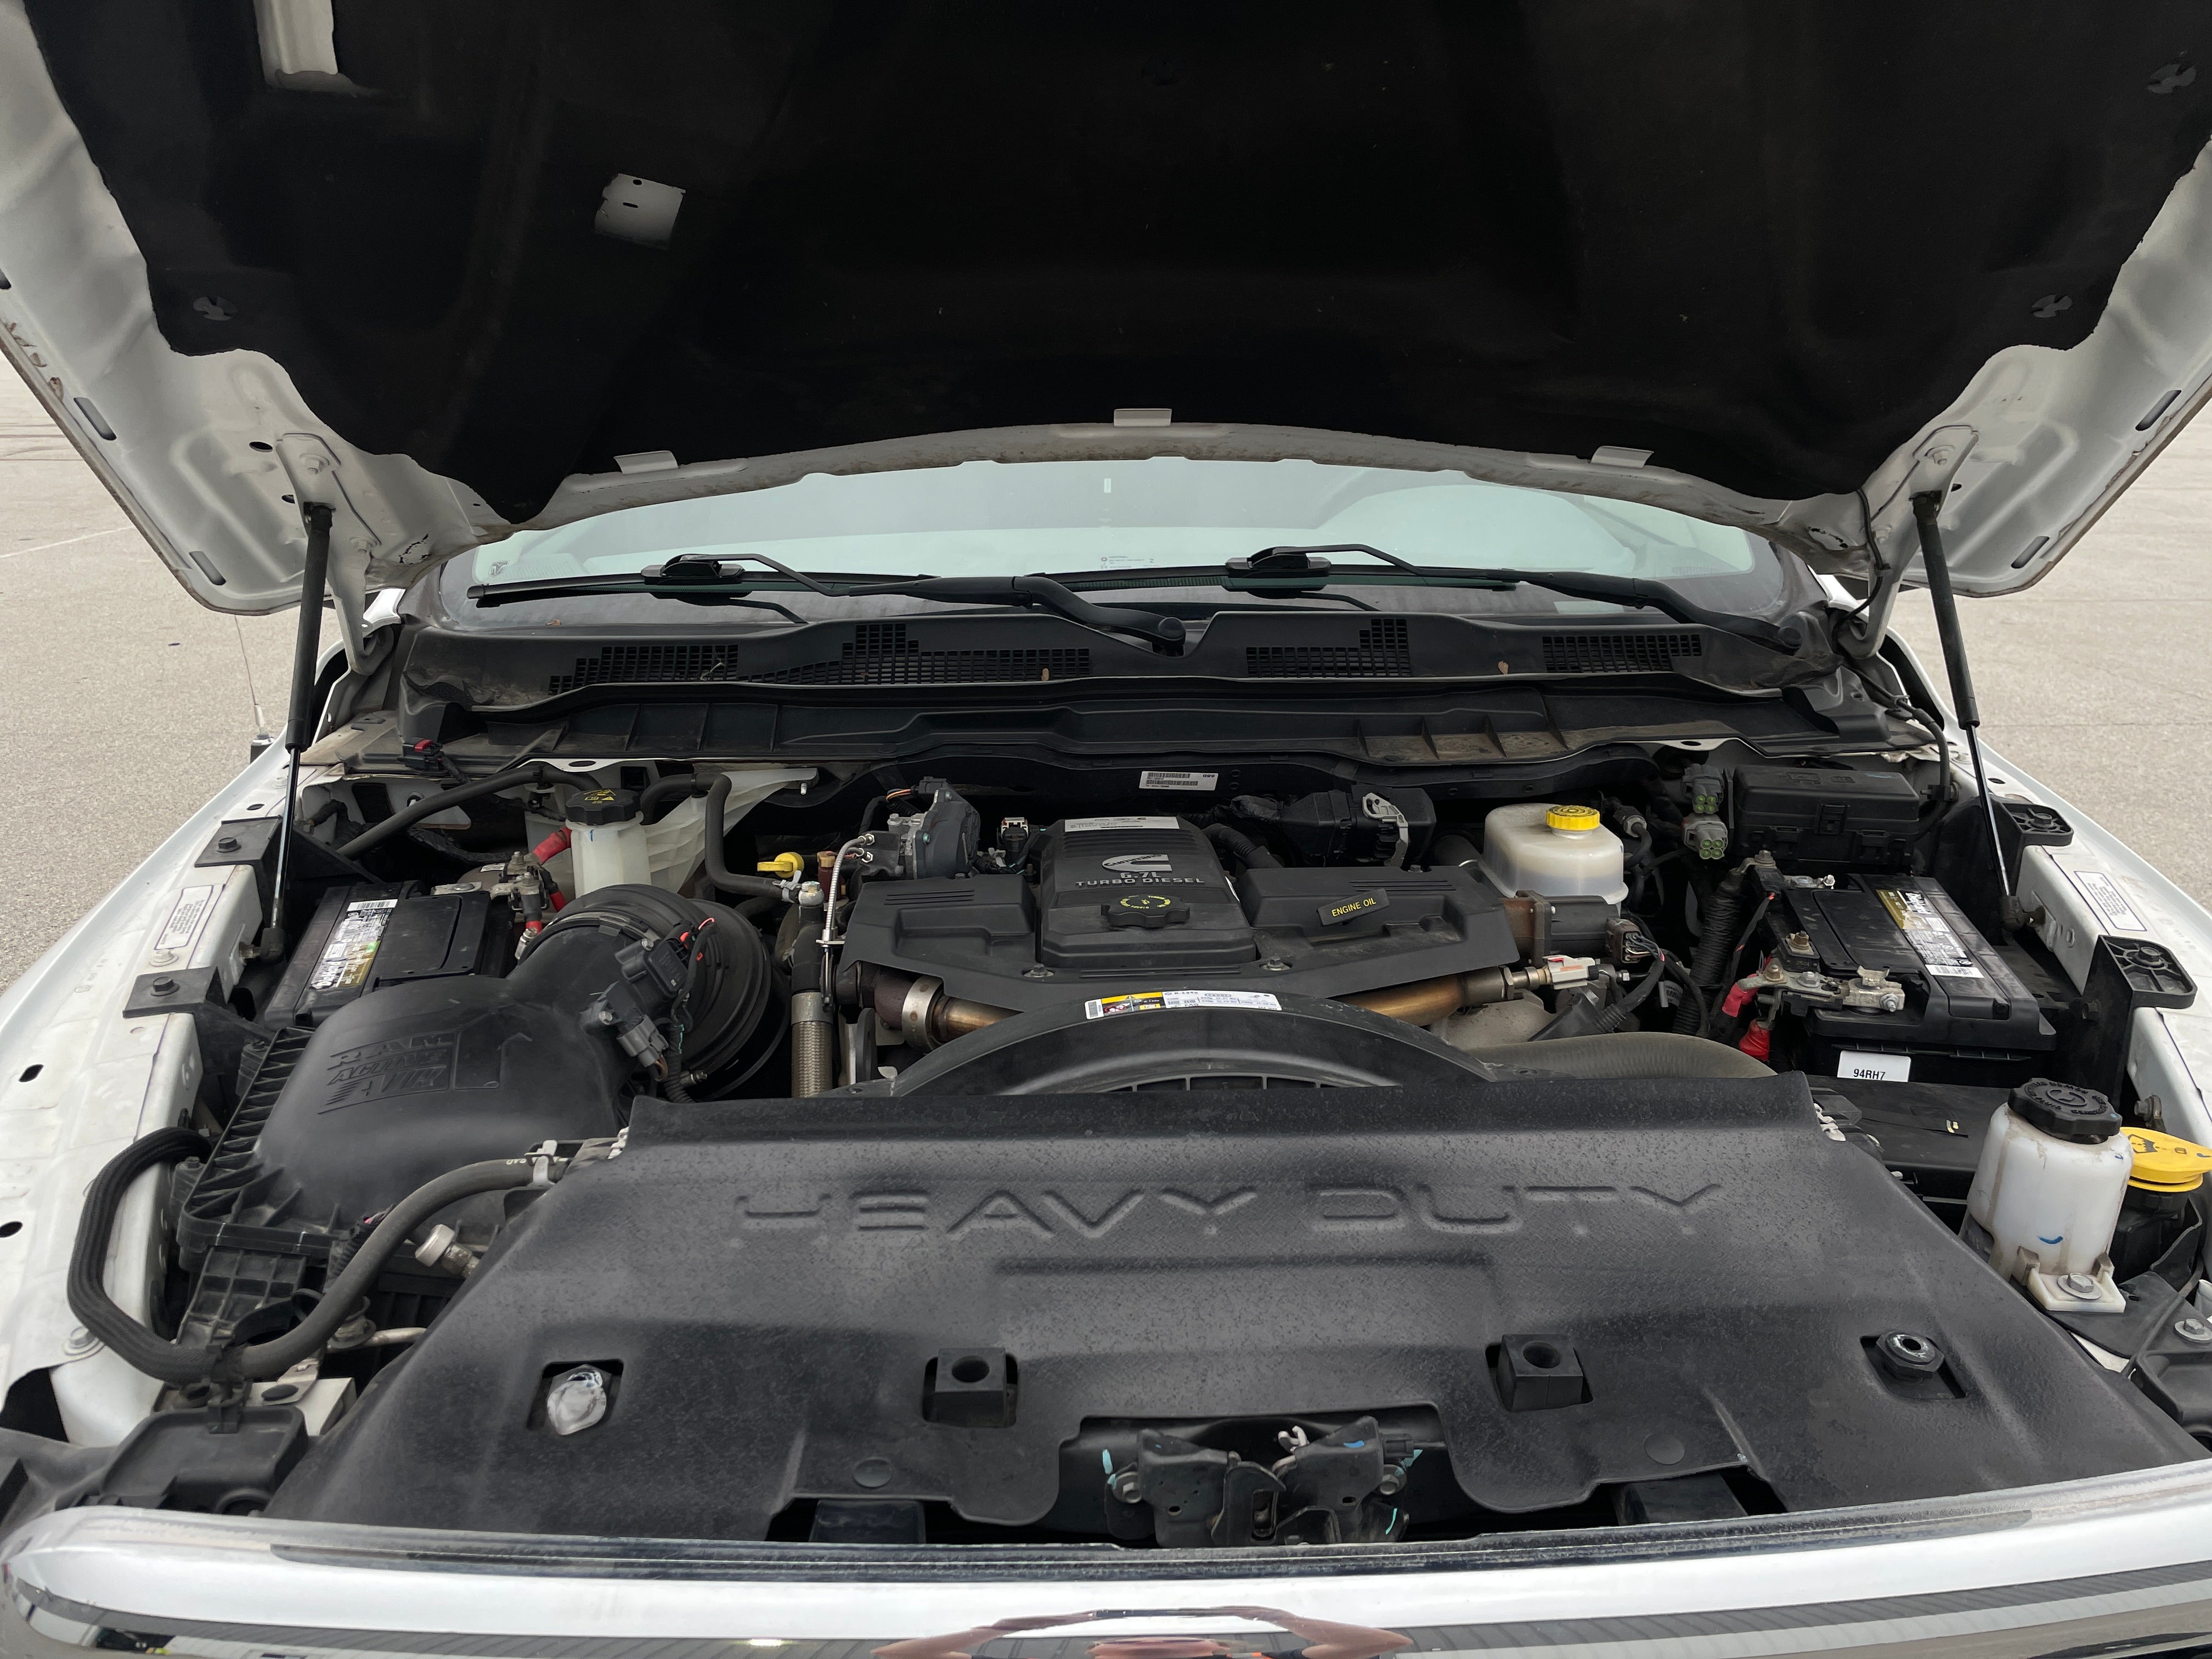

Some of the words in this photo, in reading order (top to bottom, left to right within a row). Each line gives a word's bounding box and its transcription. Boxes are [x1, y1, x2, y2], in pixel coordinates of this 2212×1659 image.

[1104, 854, 1163, 867] Cummins
[1331, 901, 1362, 917] ENGINE
[1363, 898, 1377, 907] OIL
[1853, 1068, 1886, 1080] 94RH7
[733, 1186, 1259, 1246] HEAVY
[1310, 1183, 1723, 1237] DUTY
